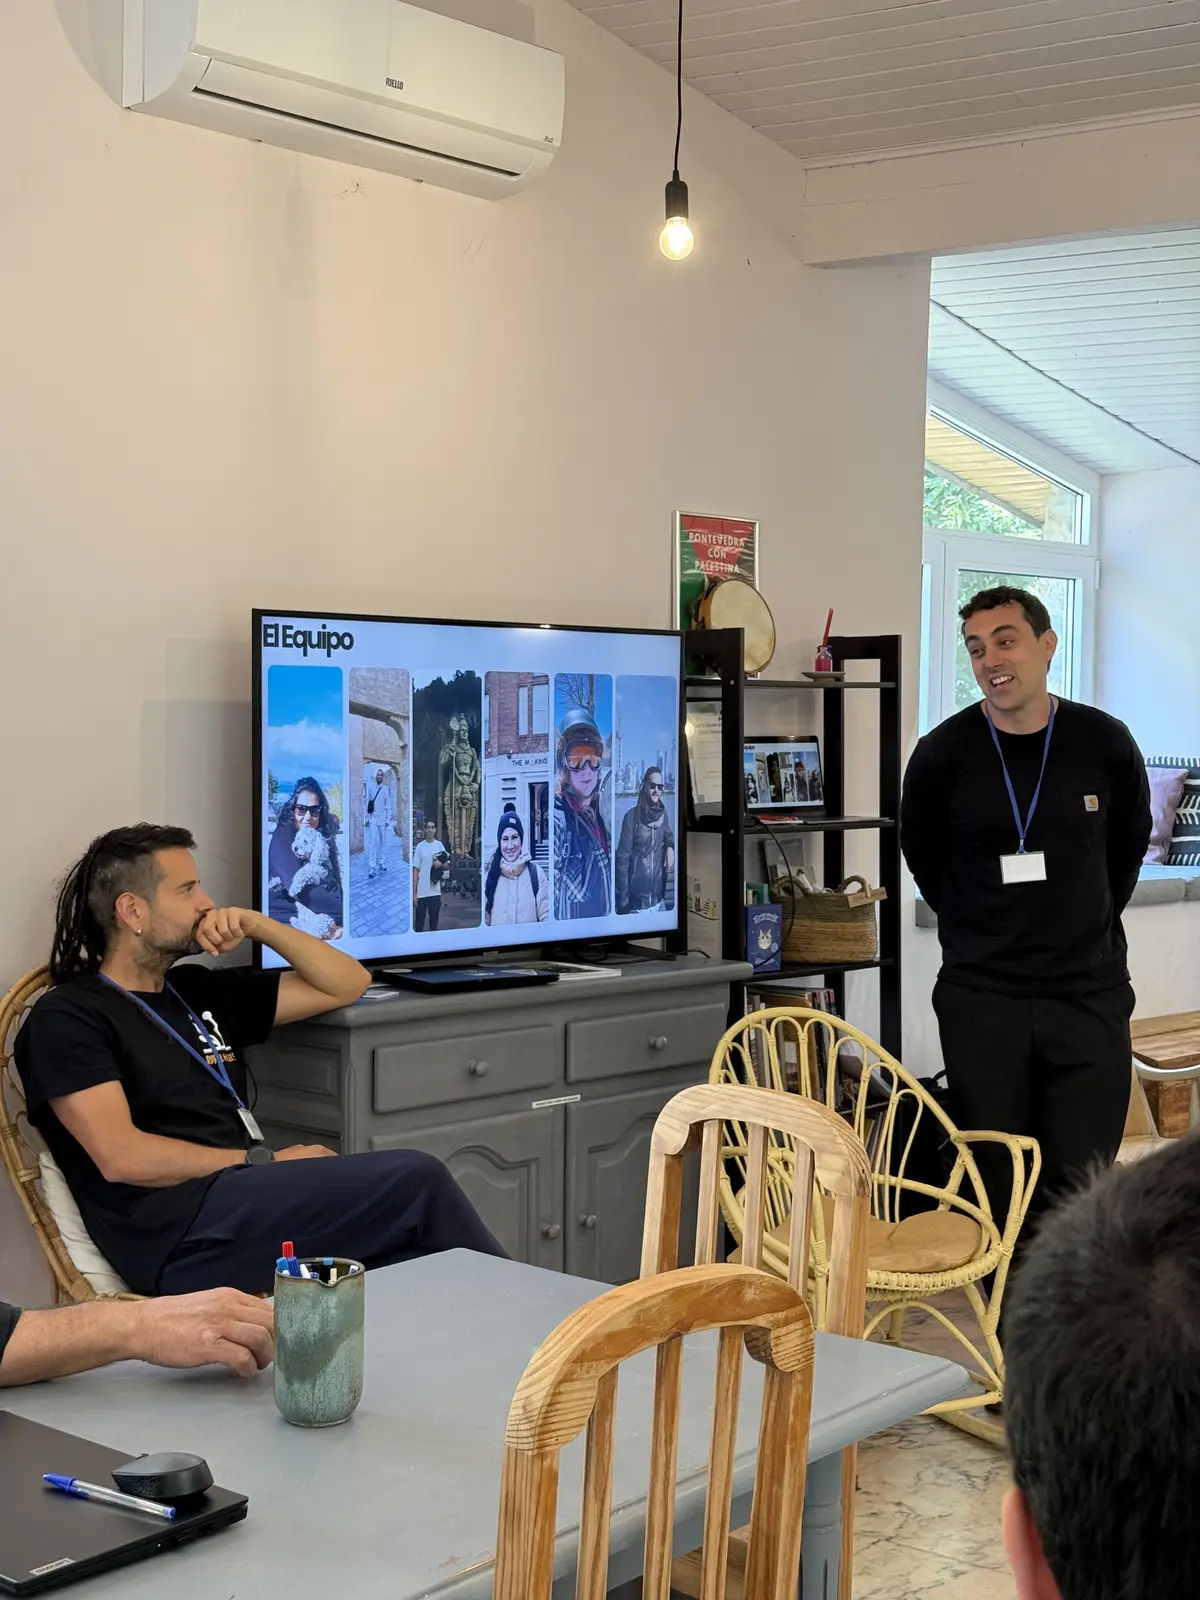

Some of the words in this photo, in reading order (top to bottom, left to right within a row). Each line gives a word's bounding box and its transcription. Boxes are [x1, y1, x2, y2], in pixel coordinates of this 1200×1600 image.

[385, 77, 404, 90] RIELLO
[688, 532, 745, 547] PONTEVEDRA
[707, 548, 727, 559] CON
[694, 560, 740, 573] PALESTINA
[263, 623, 279, 647] El
[282, 623, 354, 658] Equipo
[511, 759, 523, 767] THE
